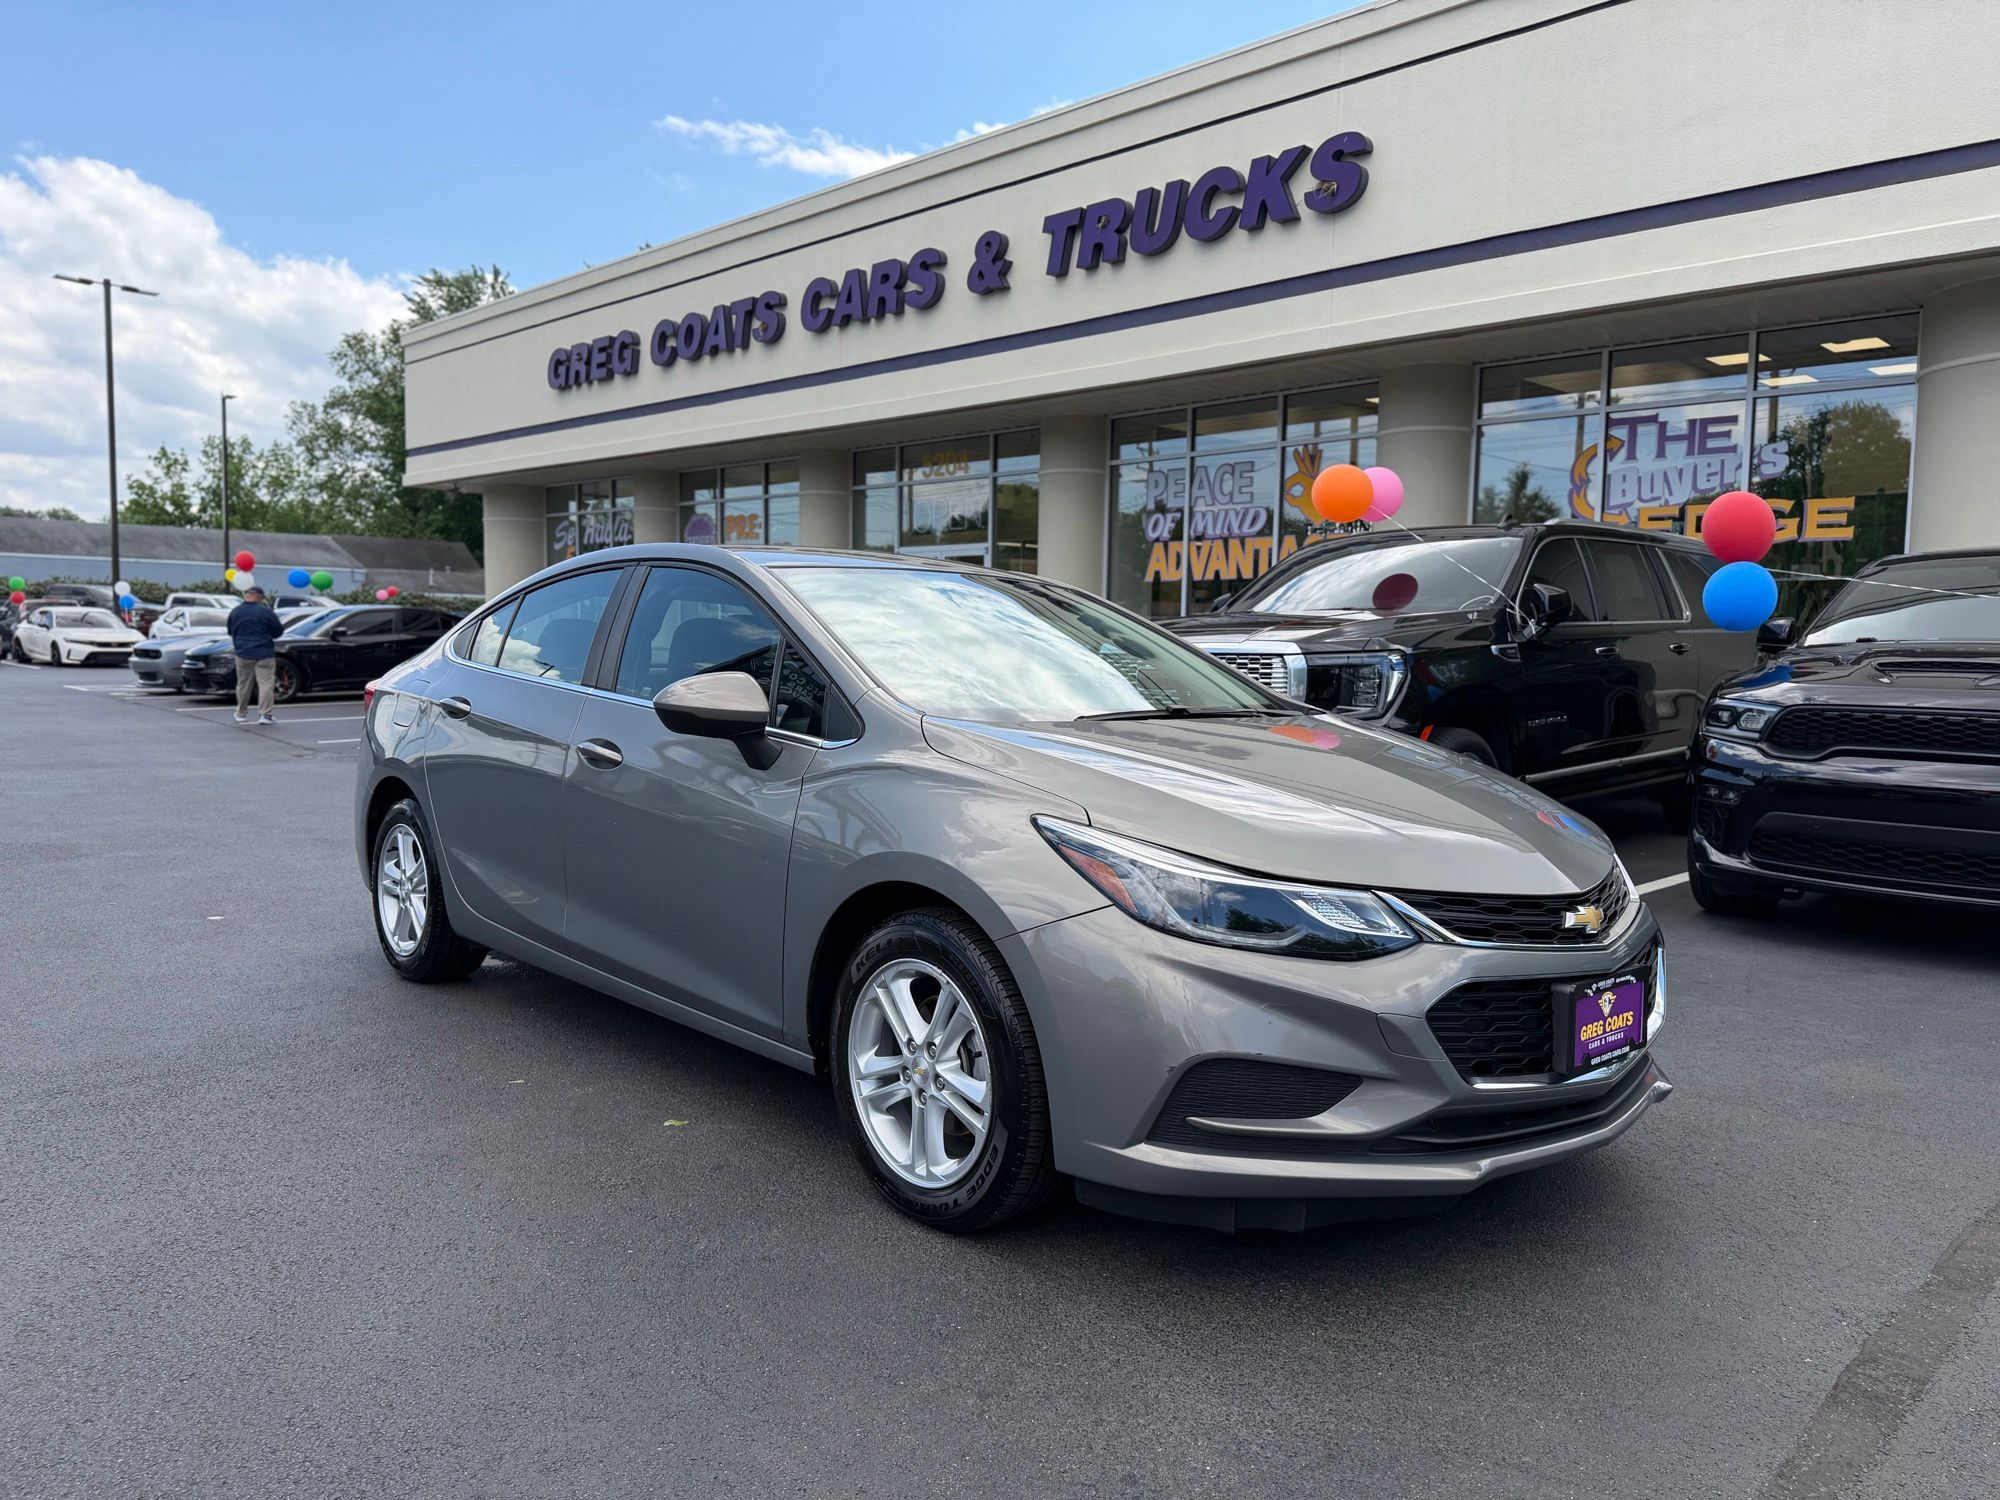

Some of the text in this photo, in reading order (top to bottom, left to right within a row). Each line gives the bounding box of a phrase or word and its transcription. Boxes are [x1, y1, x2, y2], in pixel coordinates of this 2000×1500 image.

[547, 131, 1373, 390] GREG COATS CARS & TRUCKS
[1608, 413, 1739, 461] THE
[1147, 461, 1255, 509] PEACE
[1145, 506, 1268, 541] OF MIND
[1581, 1011, 1634, 1041] GREG COATS
